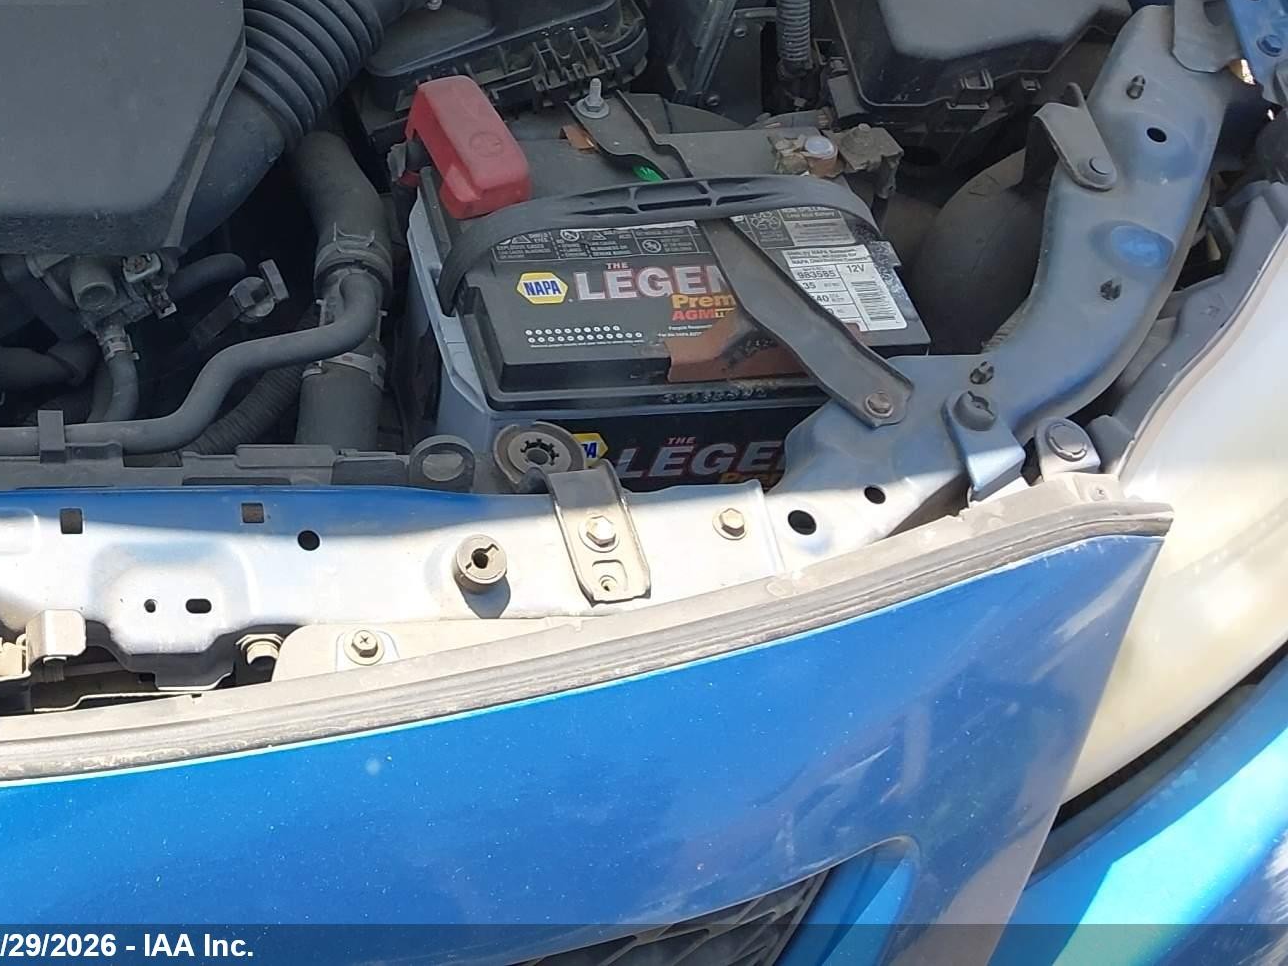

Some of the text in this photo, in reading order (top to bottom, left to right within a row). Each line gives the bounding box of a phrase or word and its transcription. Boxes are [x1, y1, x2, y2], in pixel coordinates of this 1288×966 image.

[606, 262, 629, 270] THE
[847, 264, 865, 274] 12V
[523, 279, 562, 296] NAPA
[573, 265, 730, 301] LEGEN
[802, 281, 816, 289] 35
[671, 294, 737, 309] Prem
[671, 308, 715, 320] AGM
[667, 436, 696, 445] THE
[614, 440, 784, 478] LEGE
